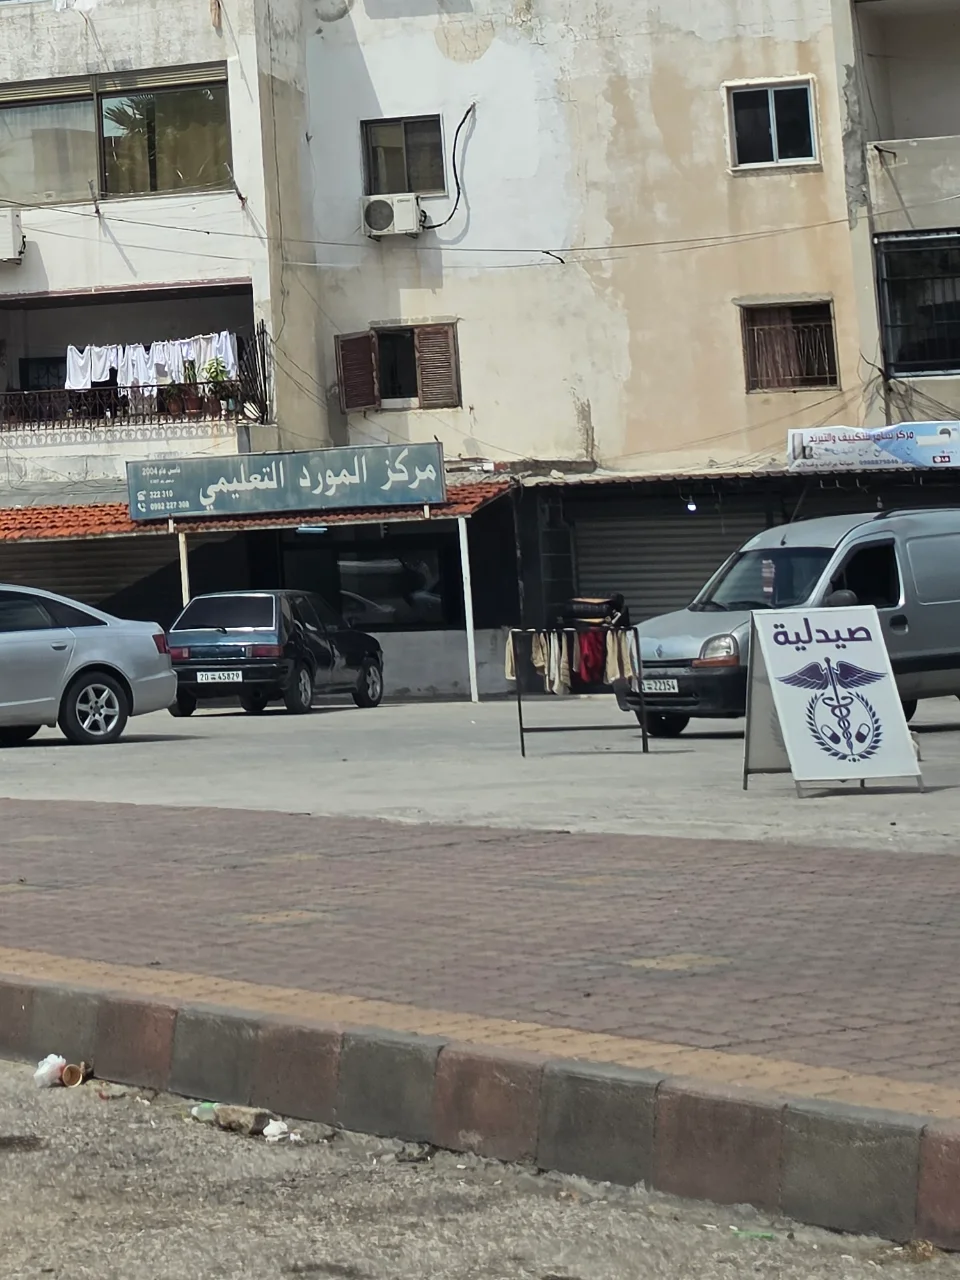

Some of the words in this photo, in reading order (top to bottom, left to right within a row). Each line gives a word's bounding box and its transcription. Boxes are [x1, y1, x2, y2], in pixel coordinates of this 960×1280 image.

[142, 467, 158, 476] 2004
[199, 460, 284, 511] التعليمي
[299, 454, 367, 496] المورد
[381, 448, 437, 490] مركز
[772, 618, 873, 652] صيدلية
